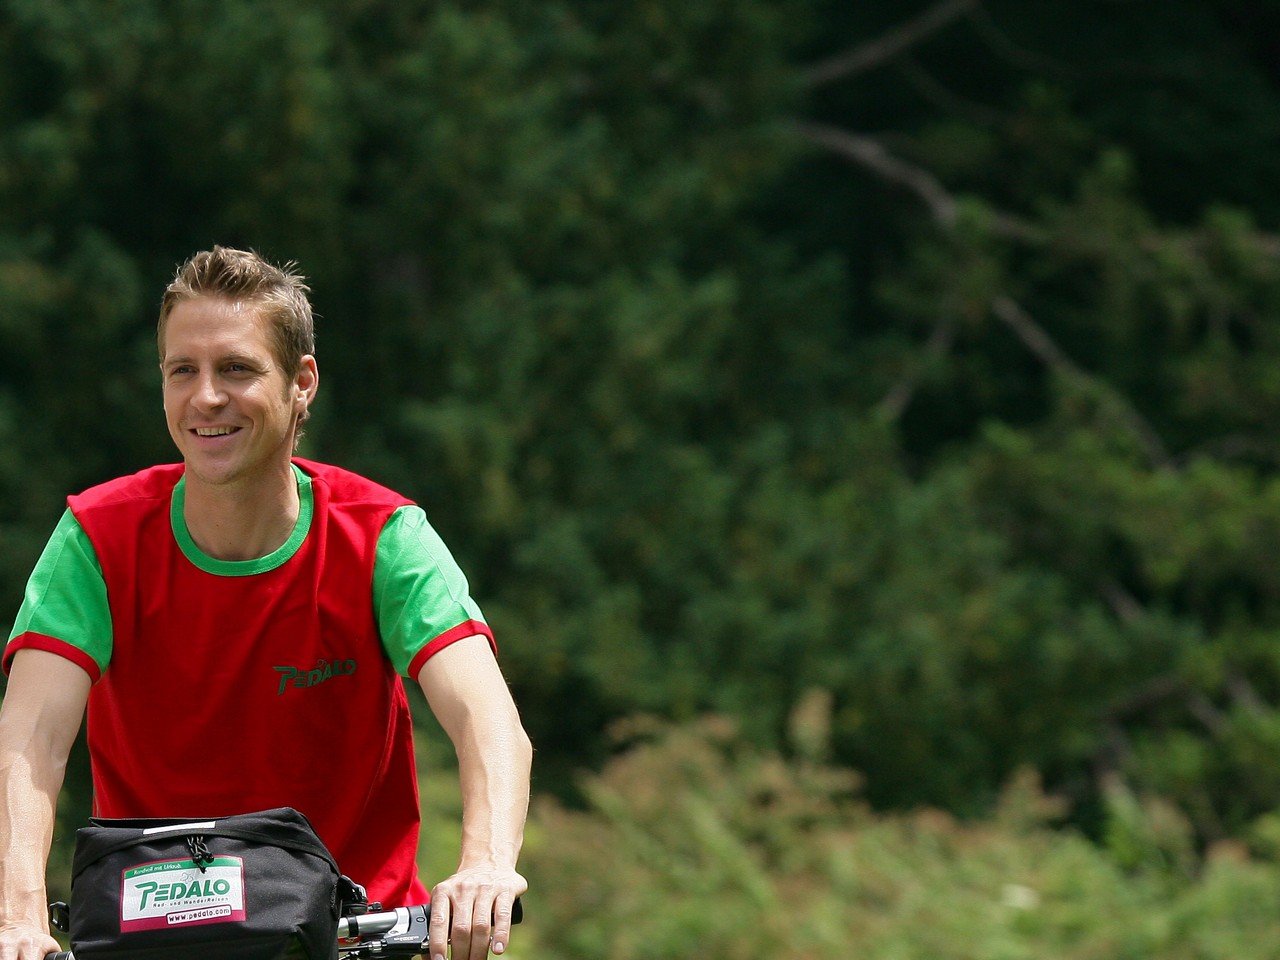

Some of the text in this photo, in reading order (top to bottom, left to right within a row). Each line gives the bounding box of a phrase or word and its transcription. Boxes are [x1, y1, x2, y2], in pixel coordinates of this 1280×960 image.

[272, 659, 358, 696] PEDALO
[134, 878, 231, 911] PEDALO
[168, 909, 230, 922] www.pedalo.com
